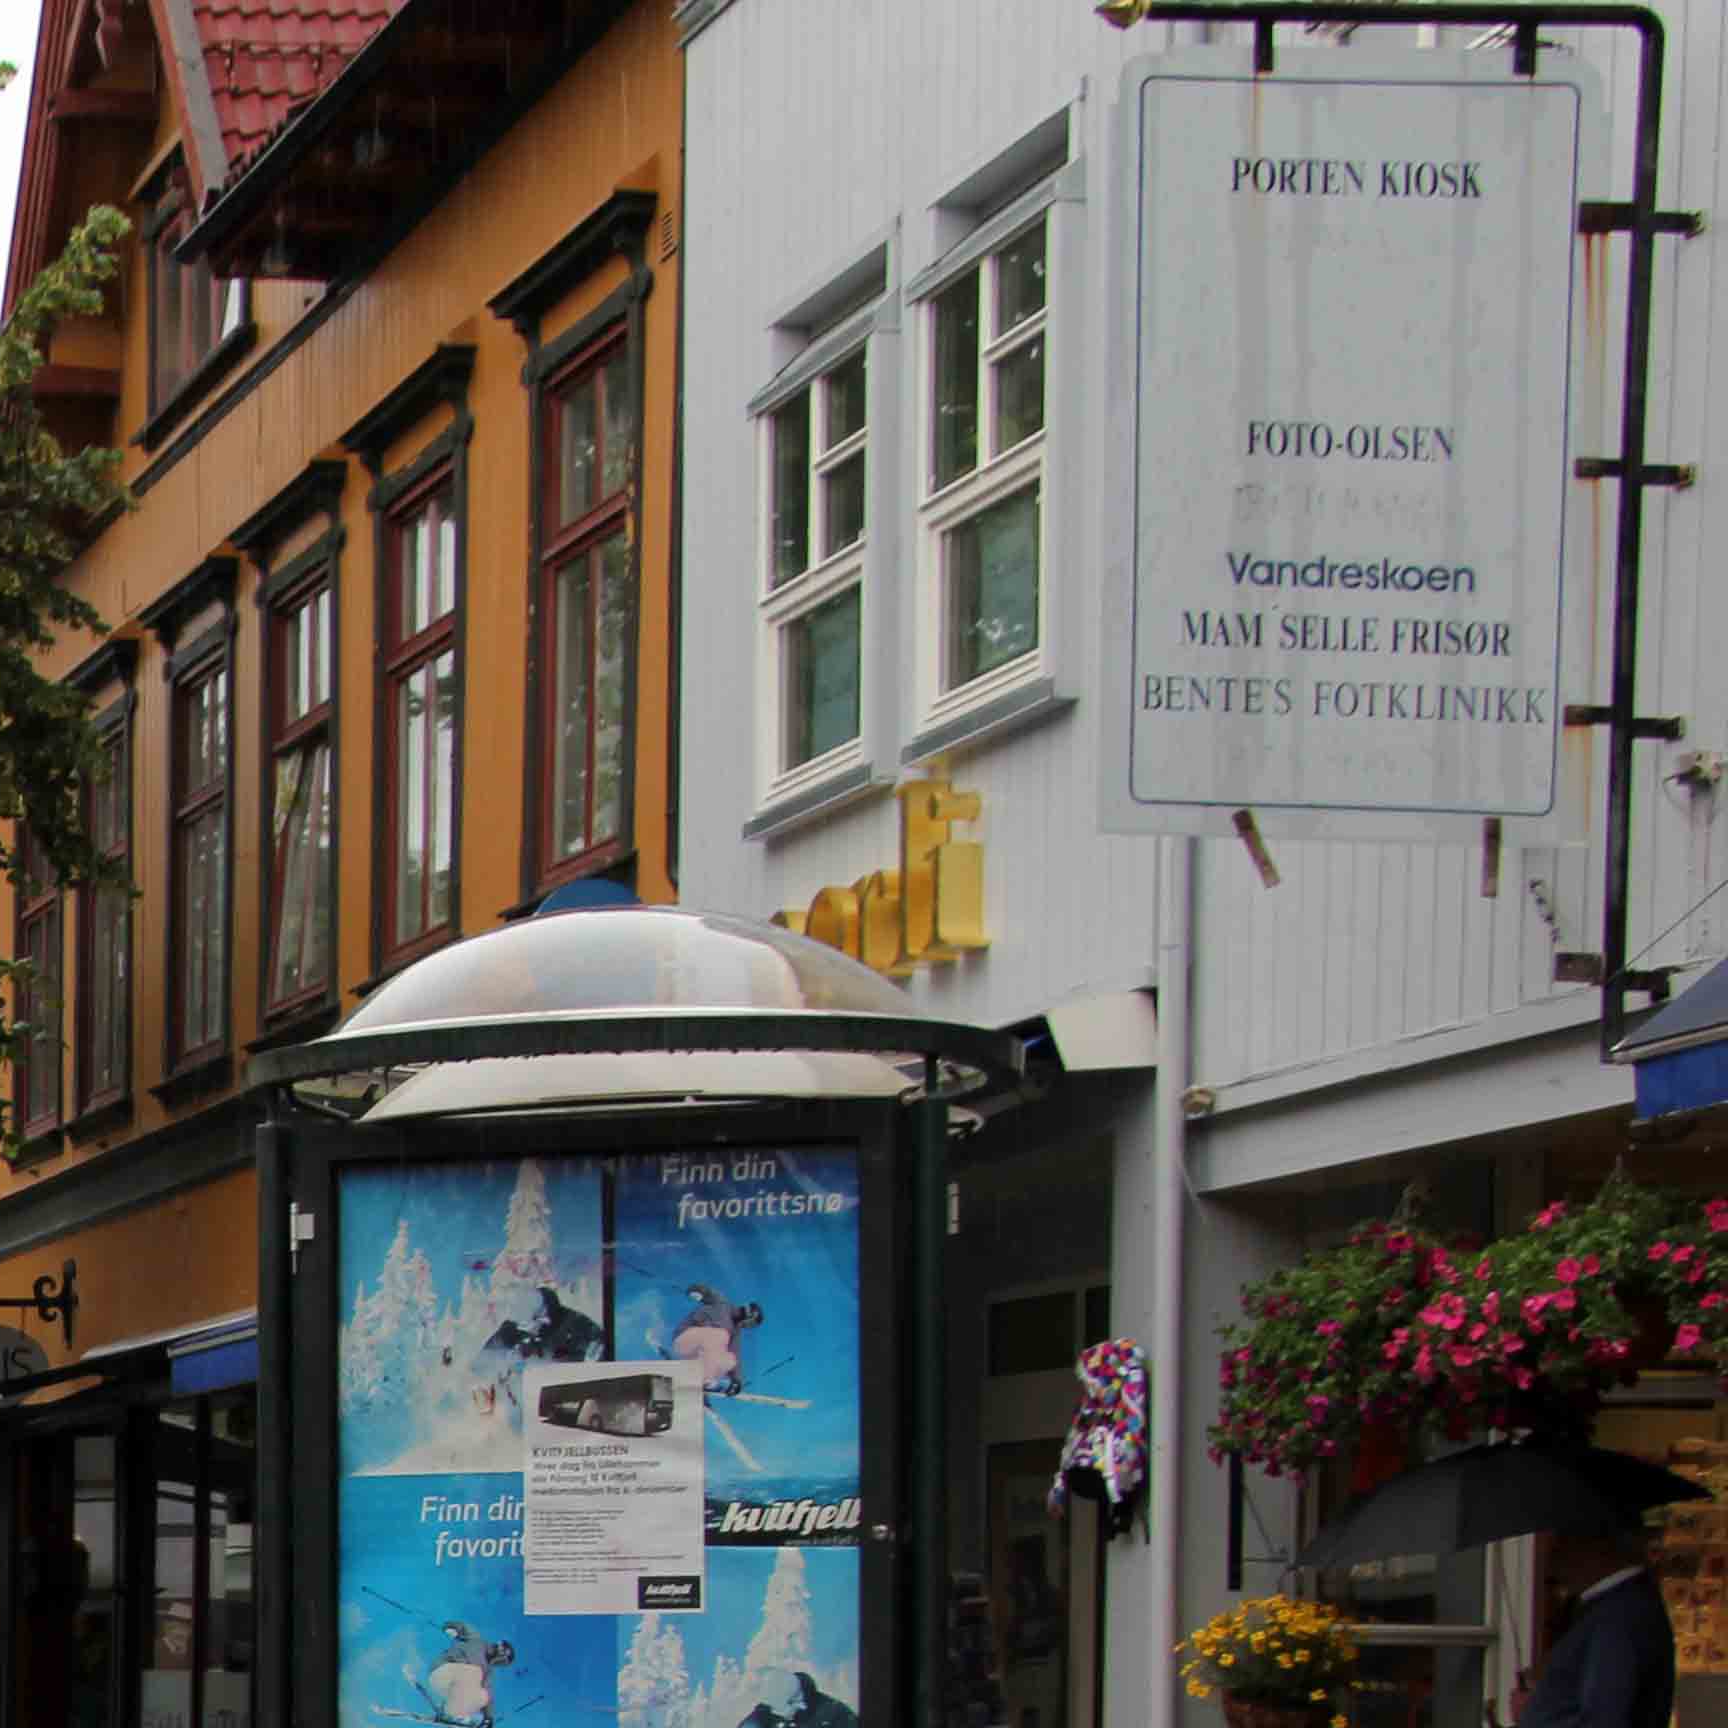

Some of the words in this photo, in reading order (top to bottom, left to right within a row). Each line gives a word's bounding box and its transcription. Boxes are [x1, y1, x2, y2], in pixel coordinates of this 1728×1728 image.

[1231, 157, 1364, 195] PORTEN
[1378, 159, 1484, 199] KIOSK
[1246, 420, 1456, 463] FOTO-OLSEN
[1226, 551, 1476, 593] Vandreskoen
[1391, 617, 1513, 657] FRISØR
[1313, 681, 1546, 725] FOTKLINIKK
[661, 1153, 723, 1184] Finn
[733, 1152, 776, 1181] din
[676, 1188, 844, 1229] favorittsnø
[419, 1495, 480, 1523] Finn
[722, 1497, 862, 1536] kvitfjell
